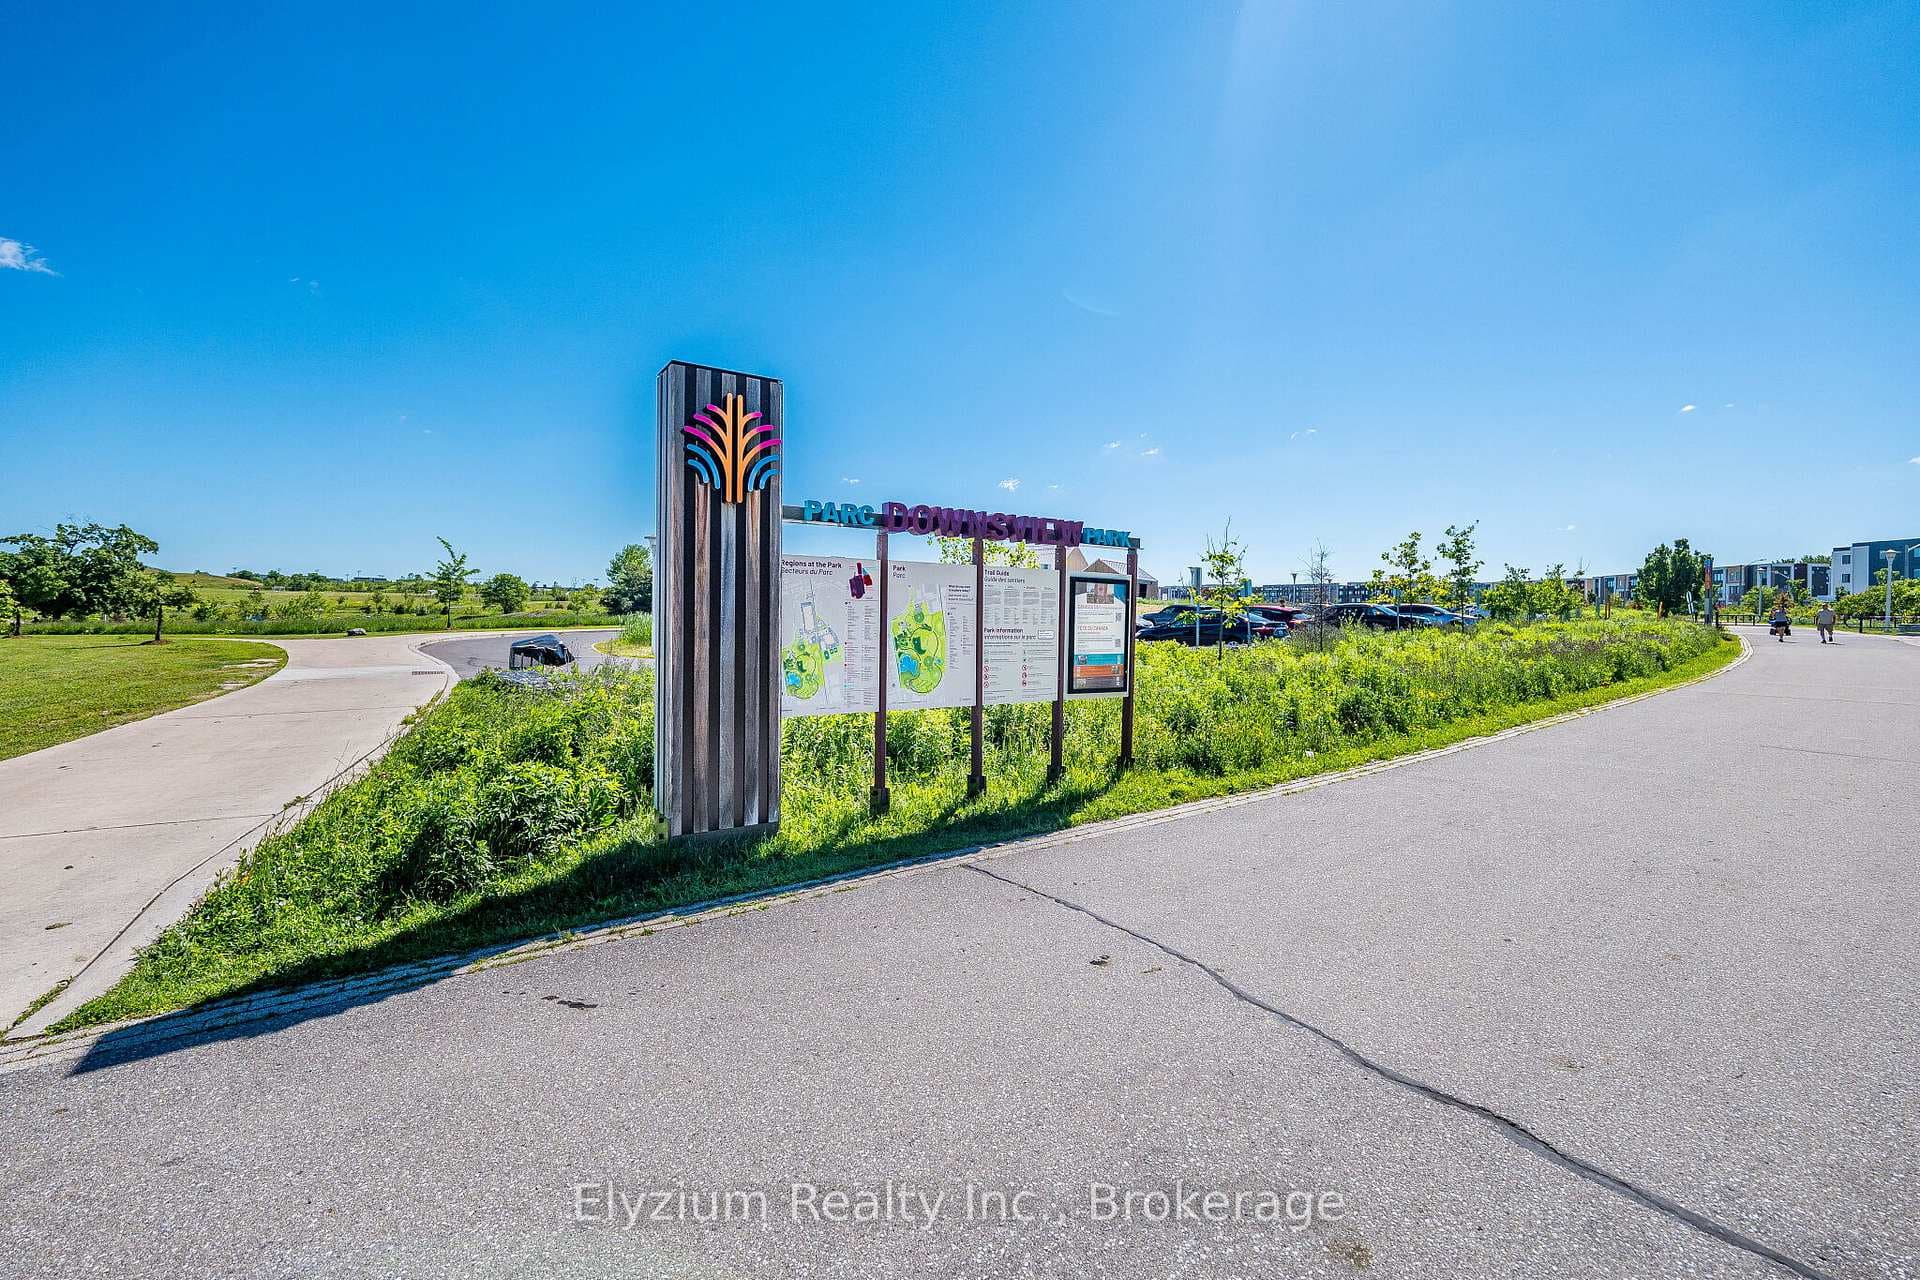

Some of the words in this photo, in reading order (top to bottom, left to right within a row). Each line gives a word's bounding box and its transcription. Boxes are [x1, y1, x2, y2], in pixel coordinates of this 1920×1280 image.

[804, 499, 875, 526] PARC
[881, 501, 1084, 547] DOWNSVIEW
[1082, 527, 1131, 548] PARK
